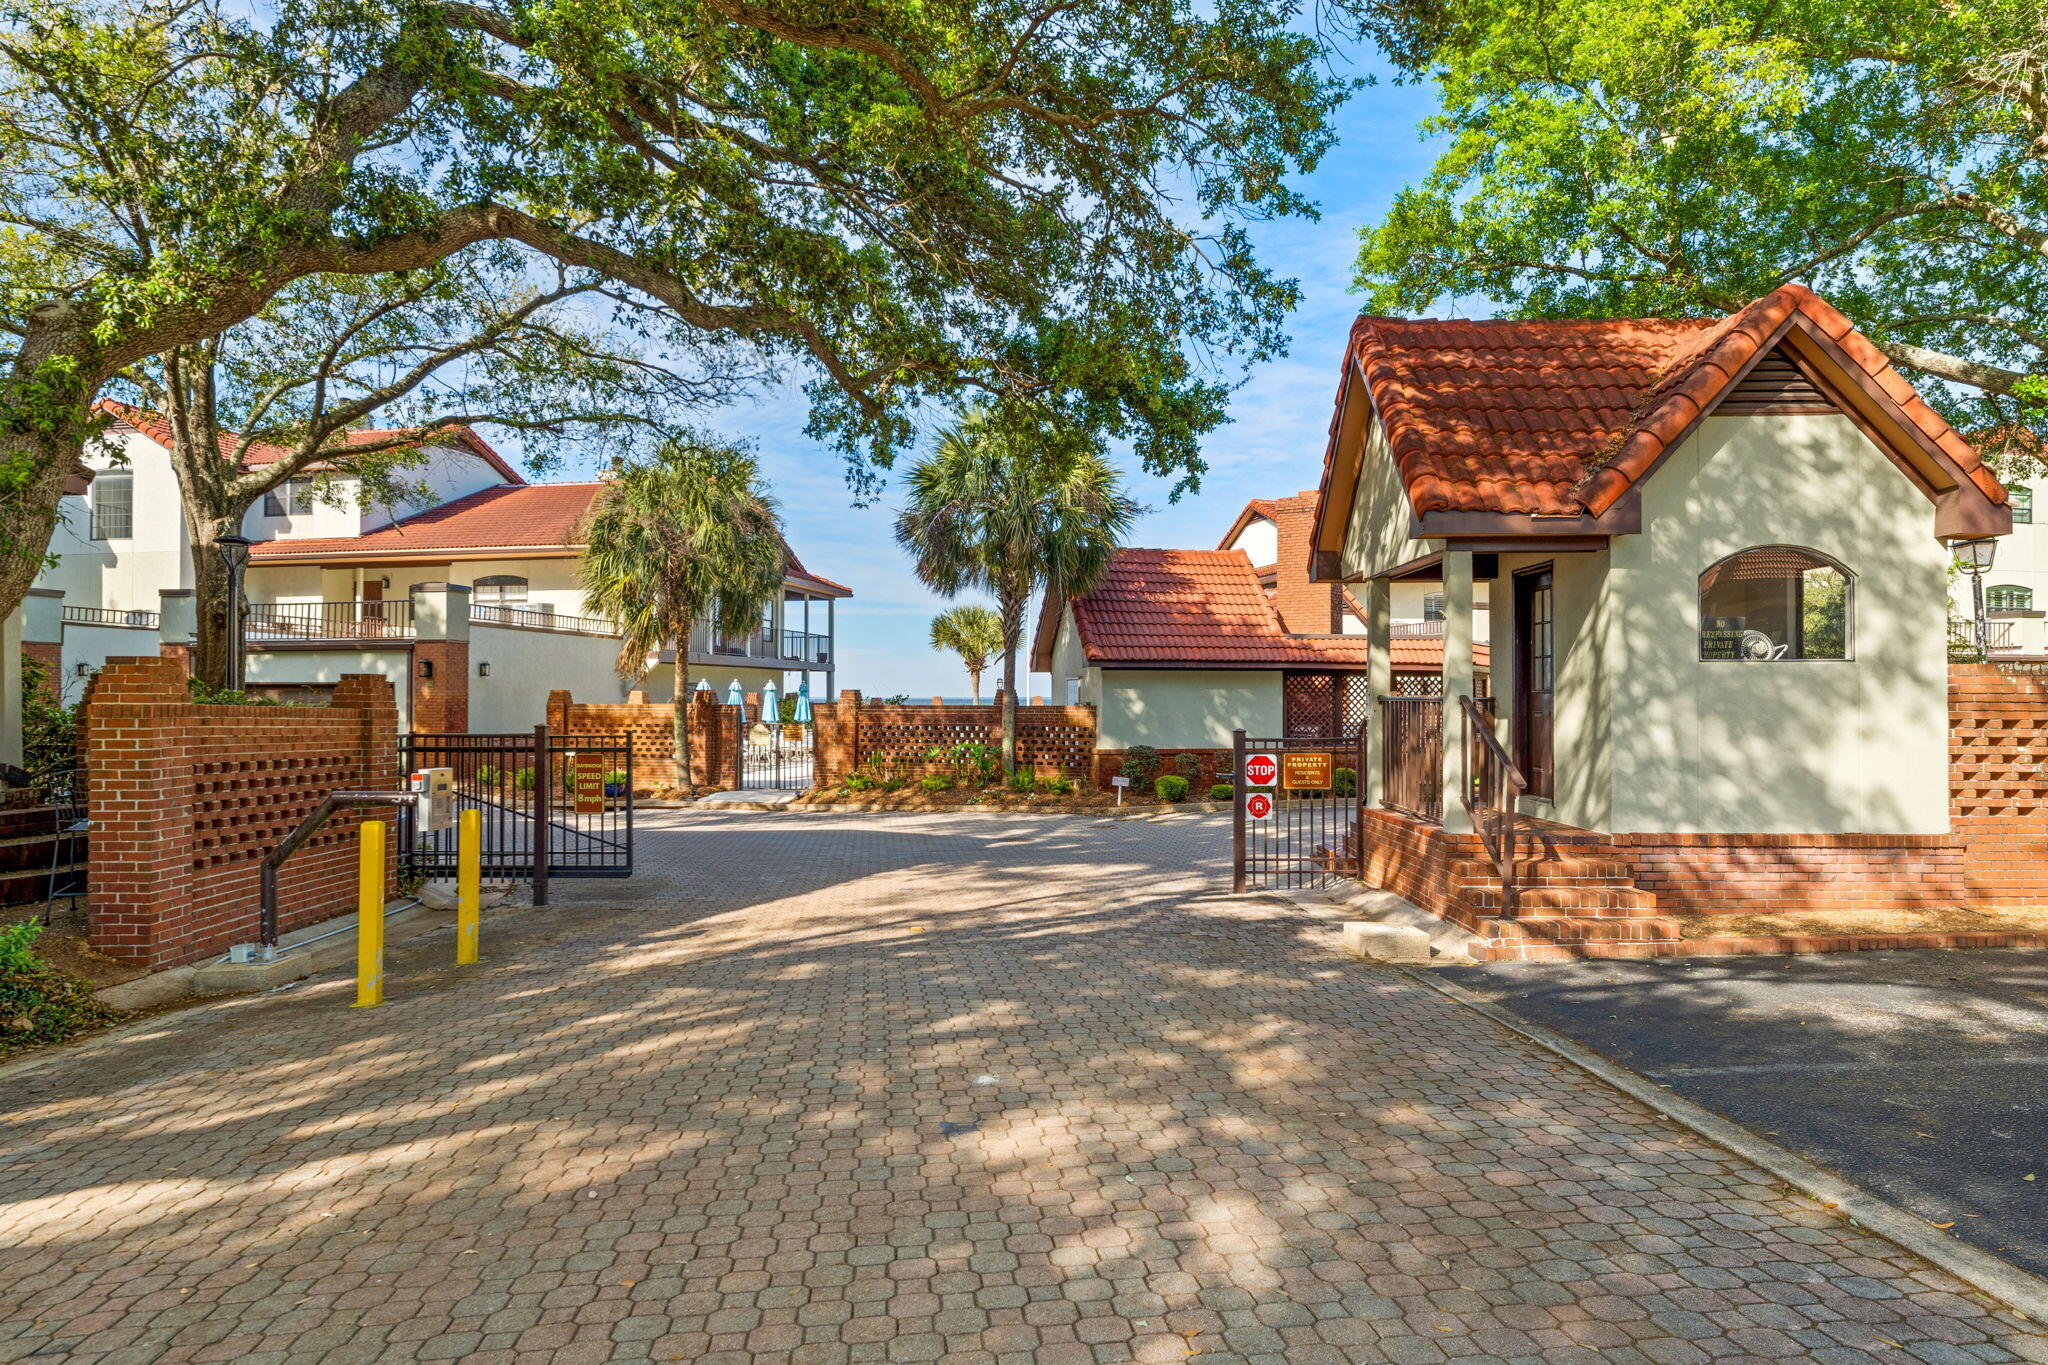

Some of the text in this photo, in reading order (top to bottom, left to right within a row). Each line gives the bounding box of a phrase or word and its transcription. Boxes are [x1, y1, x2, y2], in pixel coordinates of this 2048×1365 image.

[1701, 630, 1743, 638] RESPASSING
[1247, 765, 1275, 776] STOP
[577, 772, 602, 780] SPEED
[1255, 802, 1263, 810] R
